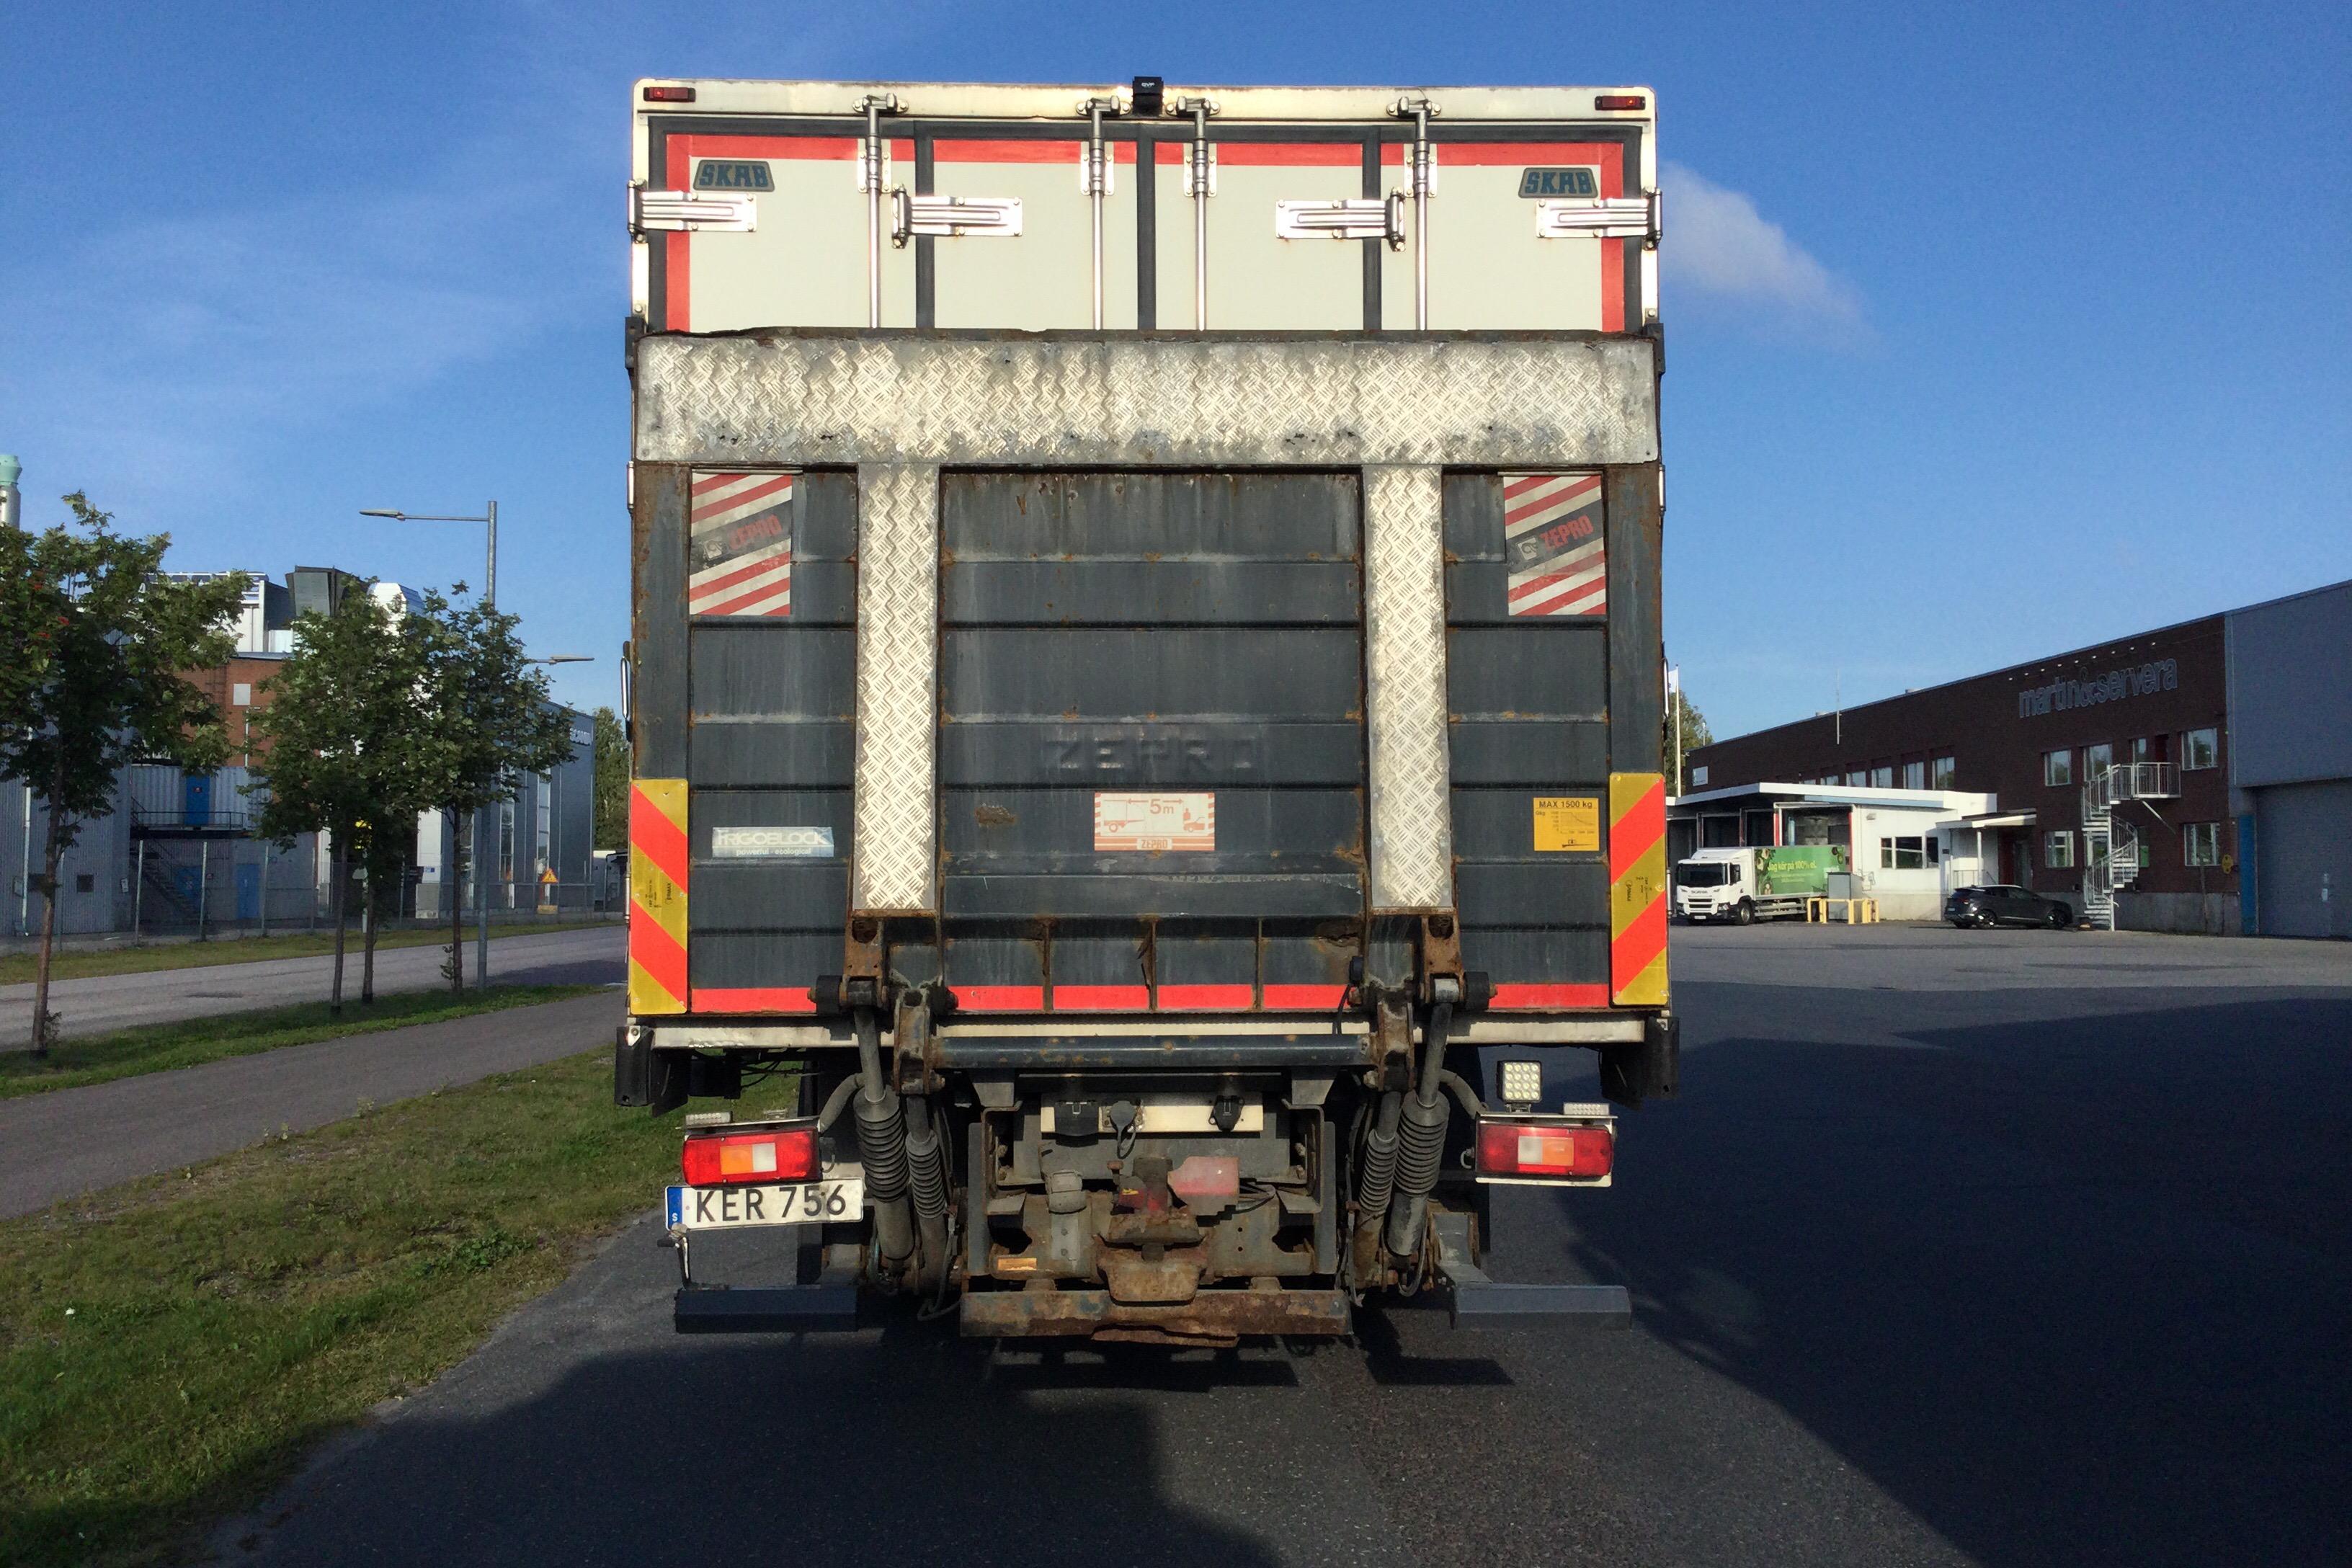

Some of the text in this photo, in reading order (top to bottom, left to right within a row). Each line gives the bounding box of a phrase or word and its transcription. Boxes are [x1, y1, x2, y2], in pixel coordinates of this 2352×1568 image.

[699, 164, 769, 187] SKAB
[1525, 172, 1592, 194] SKAB
[1539, 514, 1594, 553] ZEPRO
[1582, 801, 1593, 809] kg
[717, 829, 829, 845] FRIGOBLOCK
[1141, 839, 1169, 849] ZEPRO
[696, 1184, 846, 1223] KER 756
[672, 1212, 678, 1222] S
